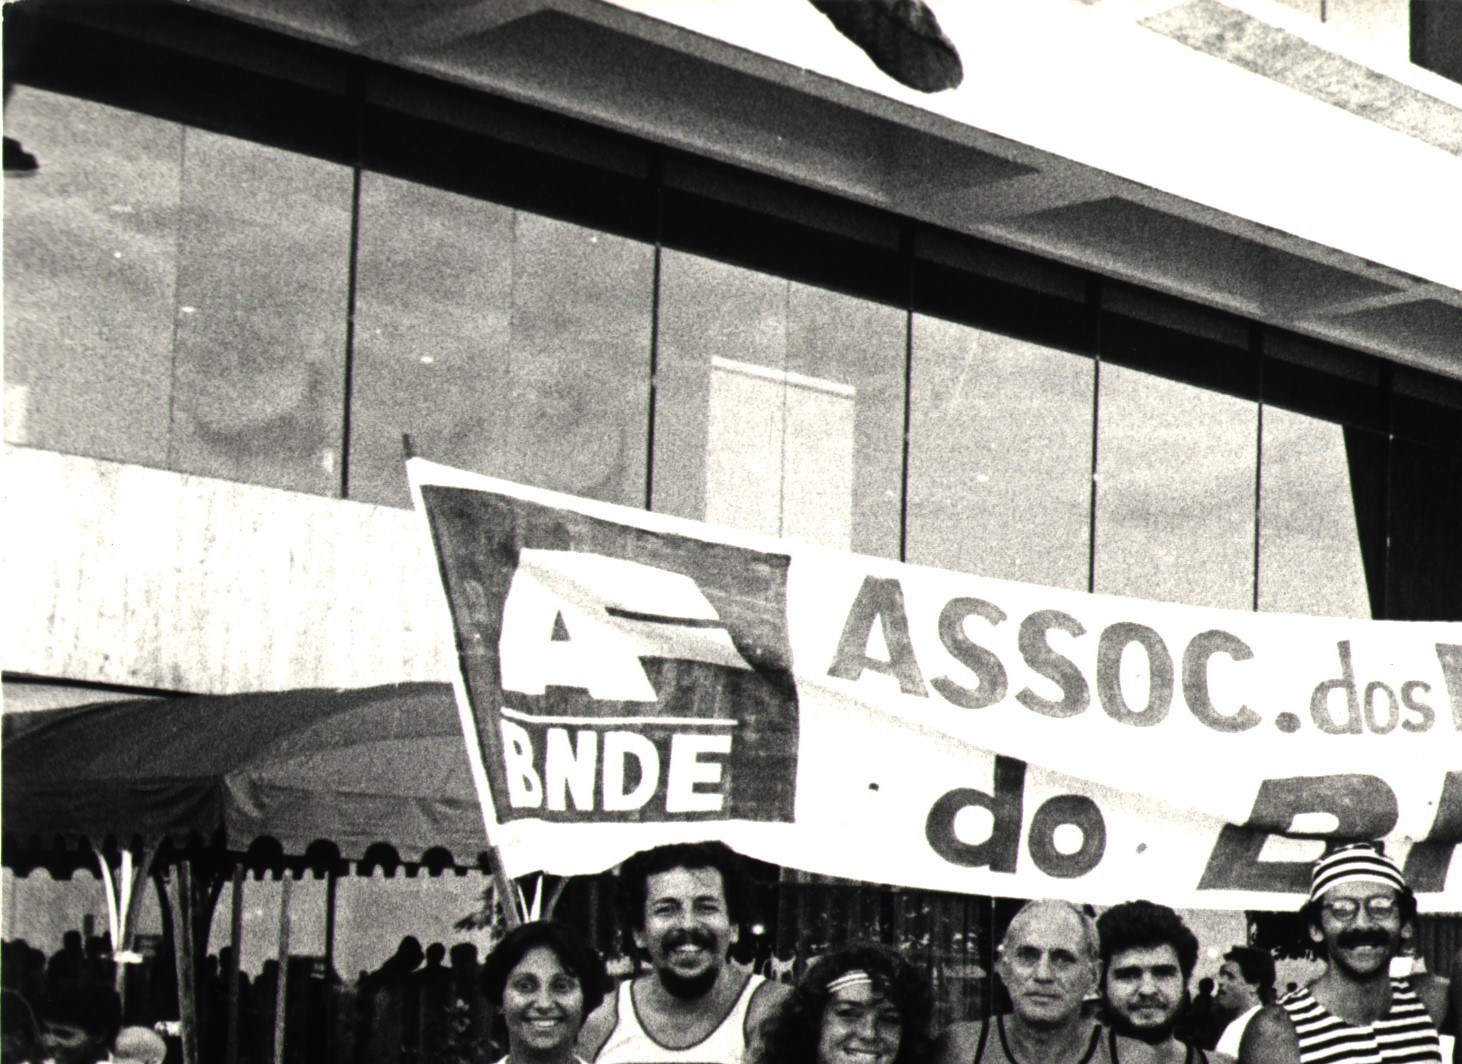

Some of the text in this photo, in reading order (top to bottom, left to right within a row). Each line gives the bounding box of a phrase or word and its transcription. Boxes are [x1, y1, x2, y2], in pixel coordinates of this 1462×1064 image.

[827, 574, 1301, 733] ASSOC.
[1310, 640, 1436, 735] dos
[499, 727, 732, 815] BNDE
[925, 753, 1107, 879] do
